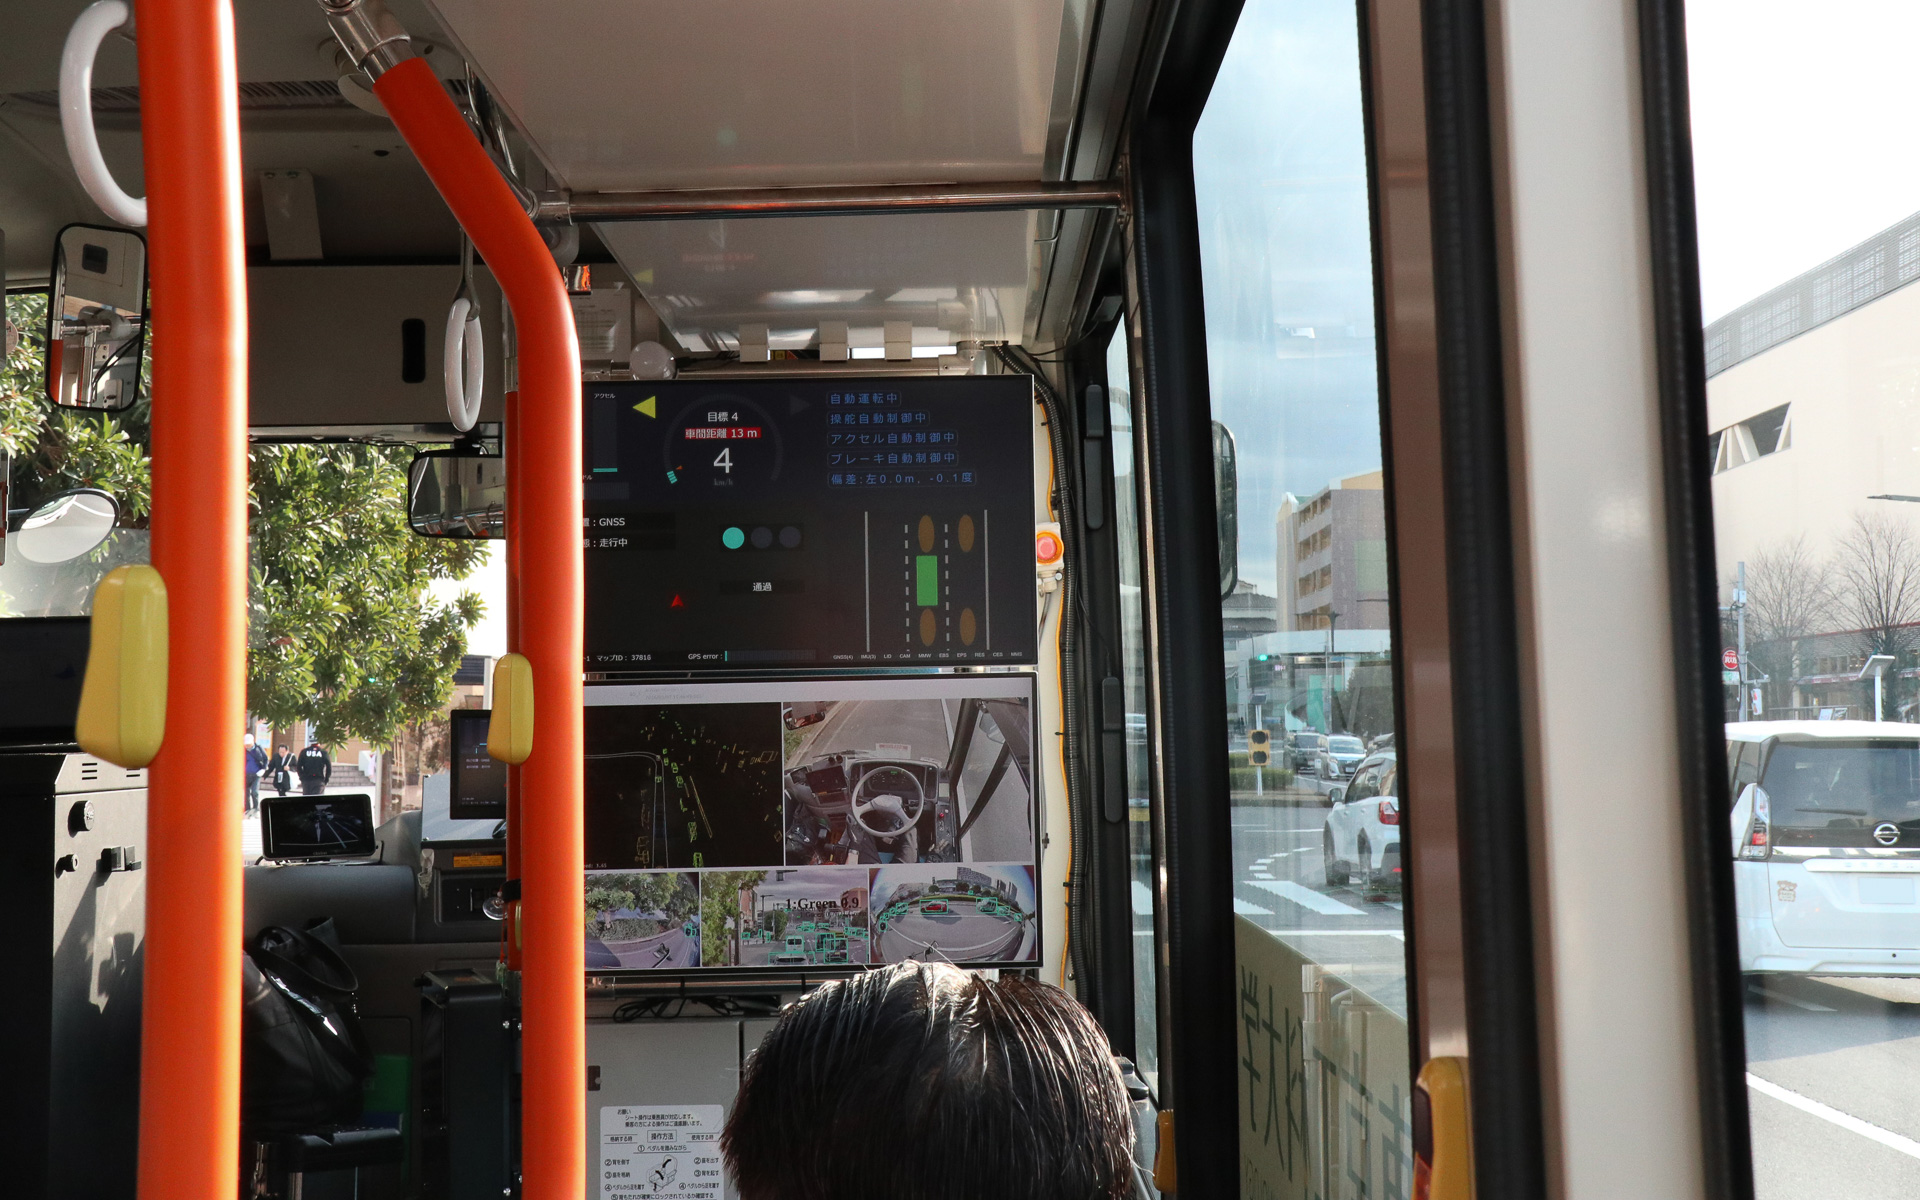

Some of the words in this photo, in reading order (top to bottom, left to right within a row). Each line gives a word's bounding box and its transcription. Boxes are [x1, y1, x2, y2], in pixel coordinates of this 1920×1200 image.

[830, 392, 898, 405] 自動運転中
[707, 411, 728, 422] 目標
[731, 412, 738, 422] 4
[830, 412, 927, 425] 操舵自動制御中
[685, 428, 728, 439] 車間距離
[731, 428, 744, 438] 13
[747, 430, 758, 438] m
[831, 432, 956, 445] アクセル自動制御中
[713, 447, 733, 474] 4
[831, 452, 956, 465] ブレーキ自動制御中
[752, 581, 772, 592] 通過
[305, 750, 322, 758] USA
[785, 897, 836, 910] 1:Green
